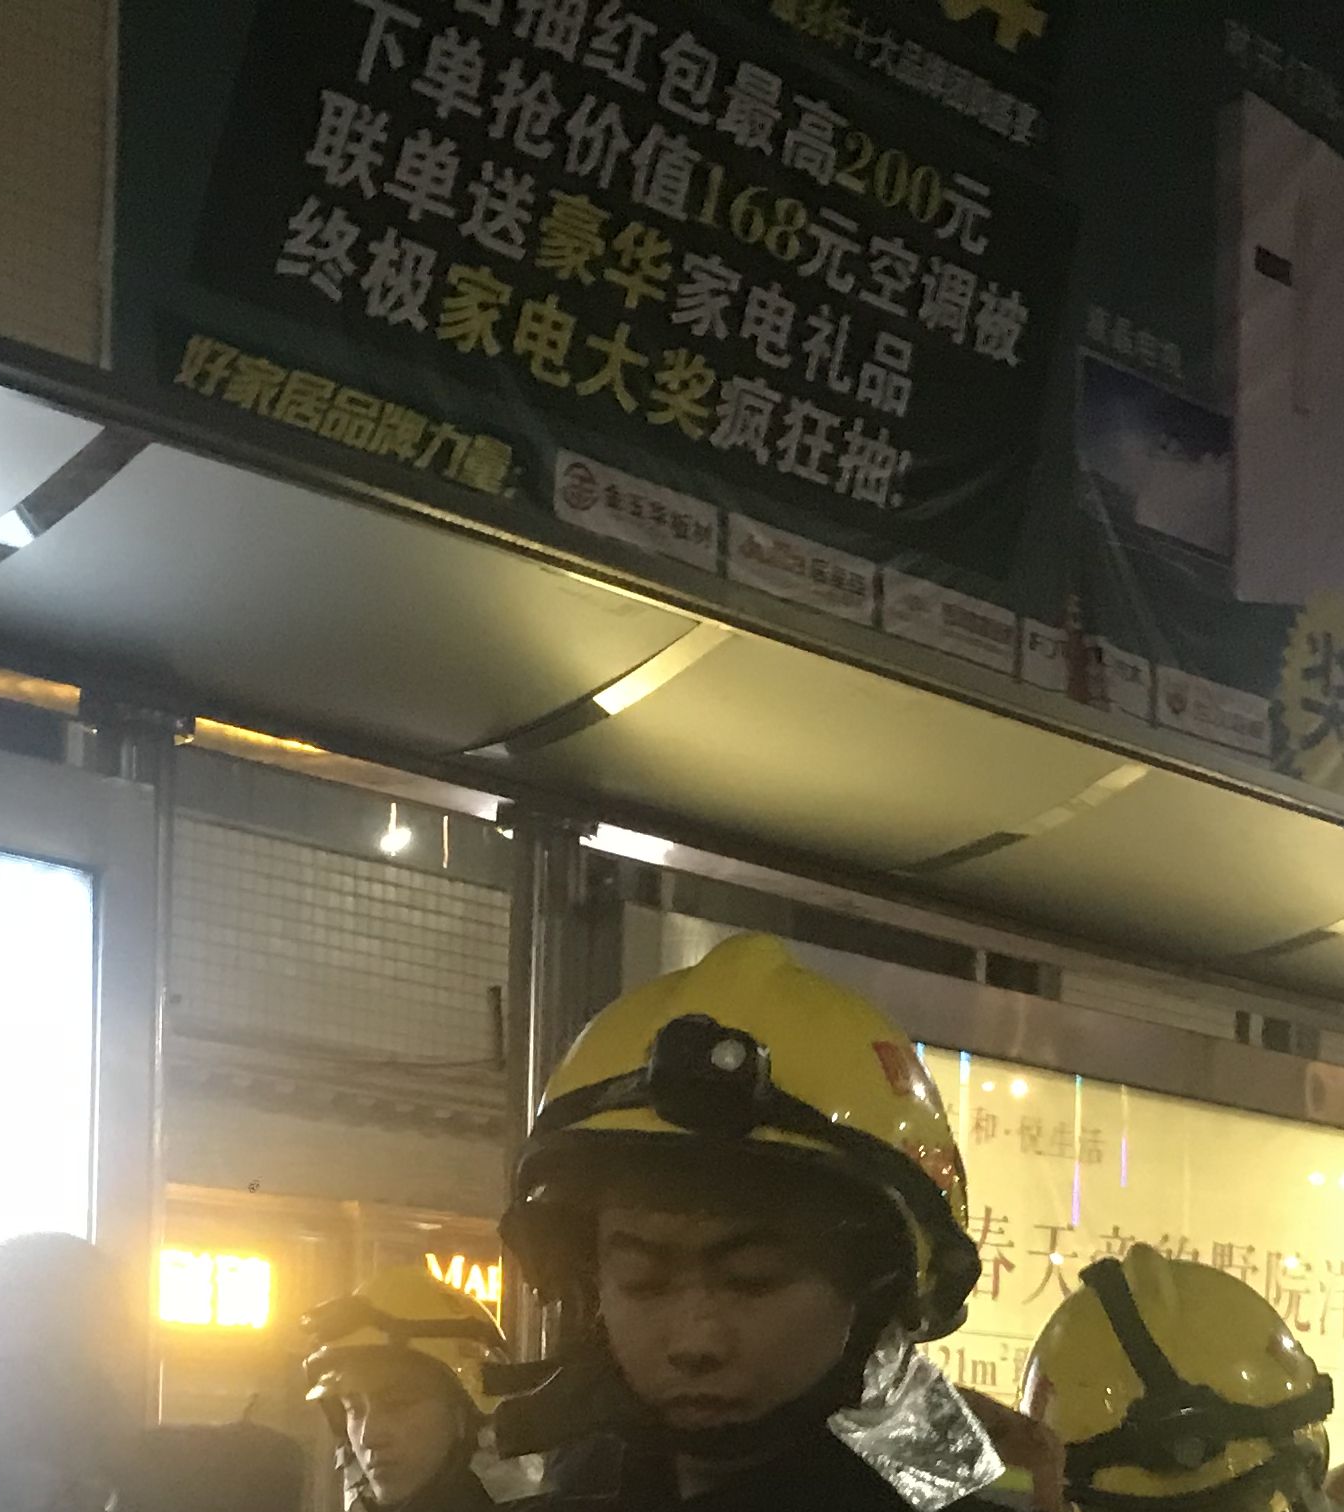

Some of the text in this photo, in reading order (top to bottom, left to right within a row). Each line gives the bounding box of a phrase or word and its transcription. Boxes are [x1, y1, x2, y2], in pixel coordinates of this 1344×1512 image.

[304, 88, 914, 417] 联单送豪华家电礼品
[356, 0, 1030, 368] 下单抢价值168元空调被
[455, 0, 992, 256] 抽红包最高200元
